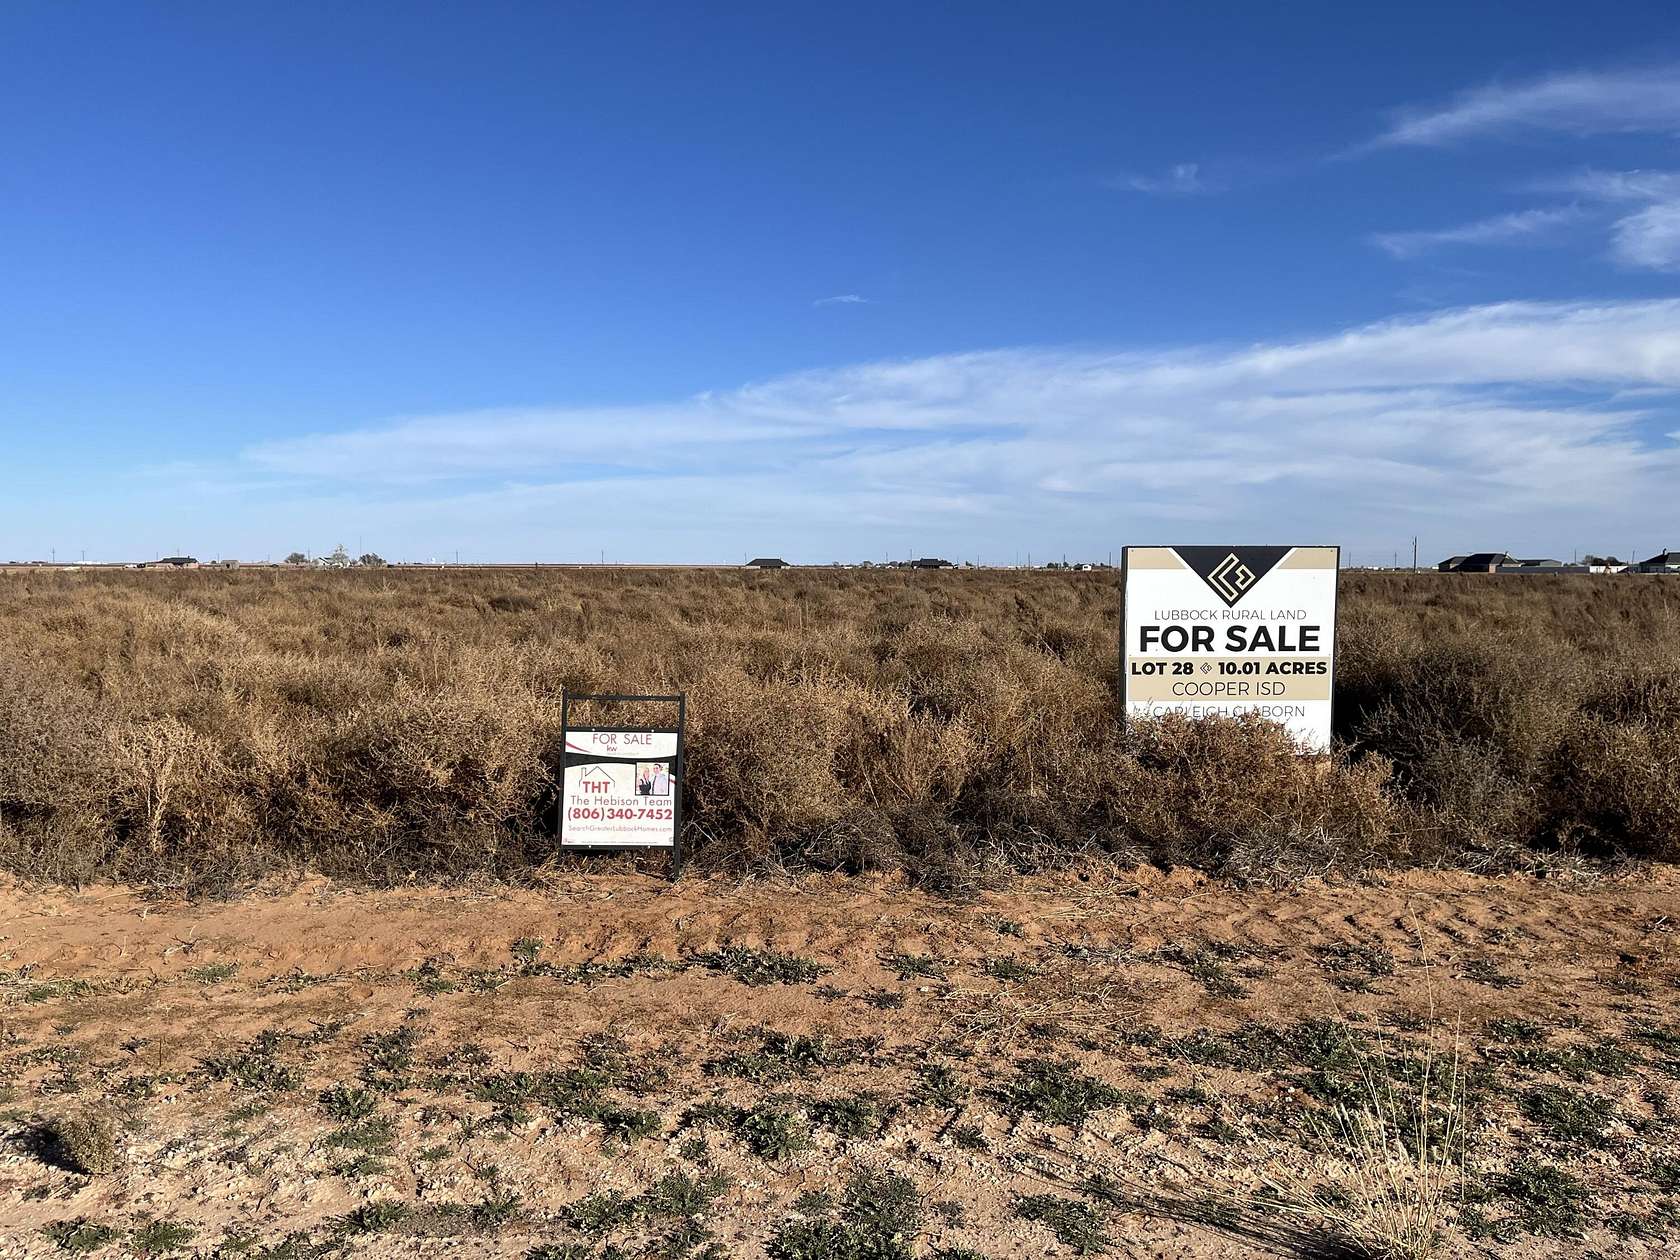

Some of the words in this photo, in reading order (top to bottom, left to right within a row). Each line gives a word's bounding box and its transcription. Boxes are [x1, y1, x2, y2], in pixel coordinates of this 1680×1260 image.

[1154, 609, 1218, 621] LUBBOCK
[1222, 609, 1266, 621] RURAL
[1270, 609, 1307, 621] LAND
[1140, 625, 1215, 652] FOR
[1225, 625, 1321, 652] SALE
[1131, 662, 1168, 675] LOT
[1172, 662, 1194, 675] 28
[1218, 662, 1261, 675] 10.01
[1266, 662, 1327, 675] ACRES
[1172, 682, 1250, 696] COOPER
[1256, 682, 1286, 696] ISD
[592, 733, 617, 745] FOR
[623, 733, 652, 745] SALE
[582, 781, 611, 794] THT
[570, 795, 590, 806] The
[594, 795, 639, 806] Hebison
[643, 796, 672, 807] Team
